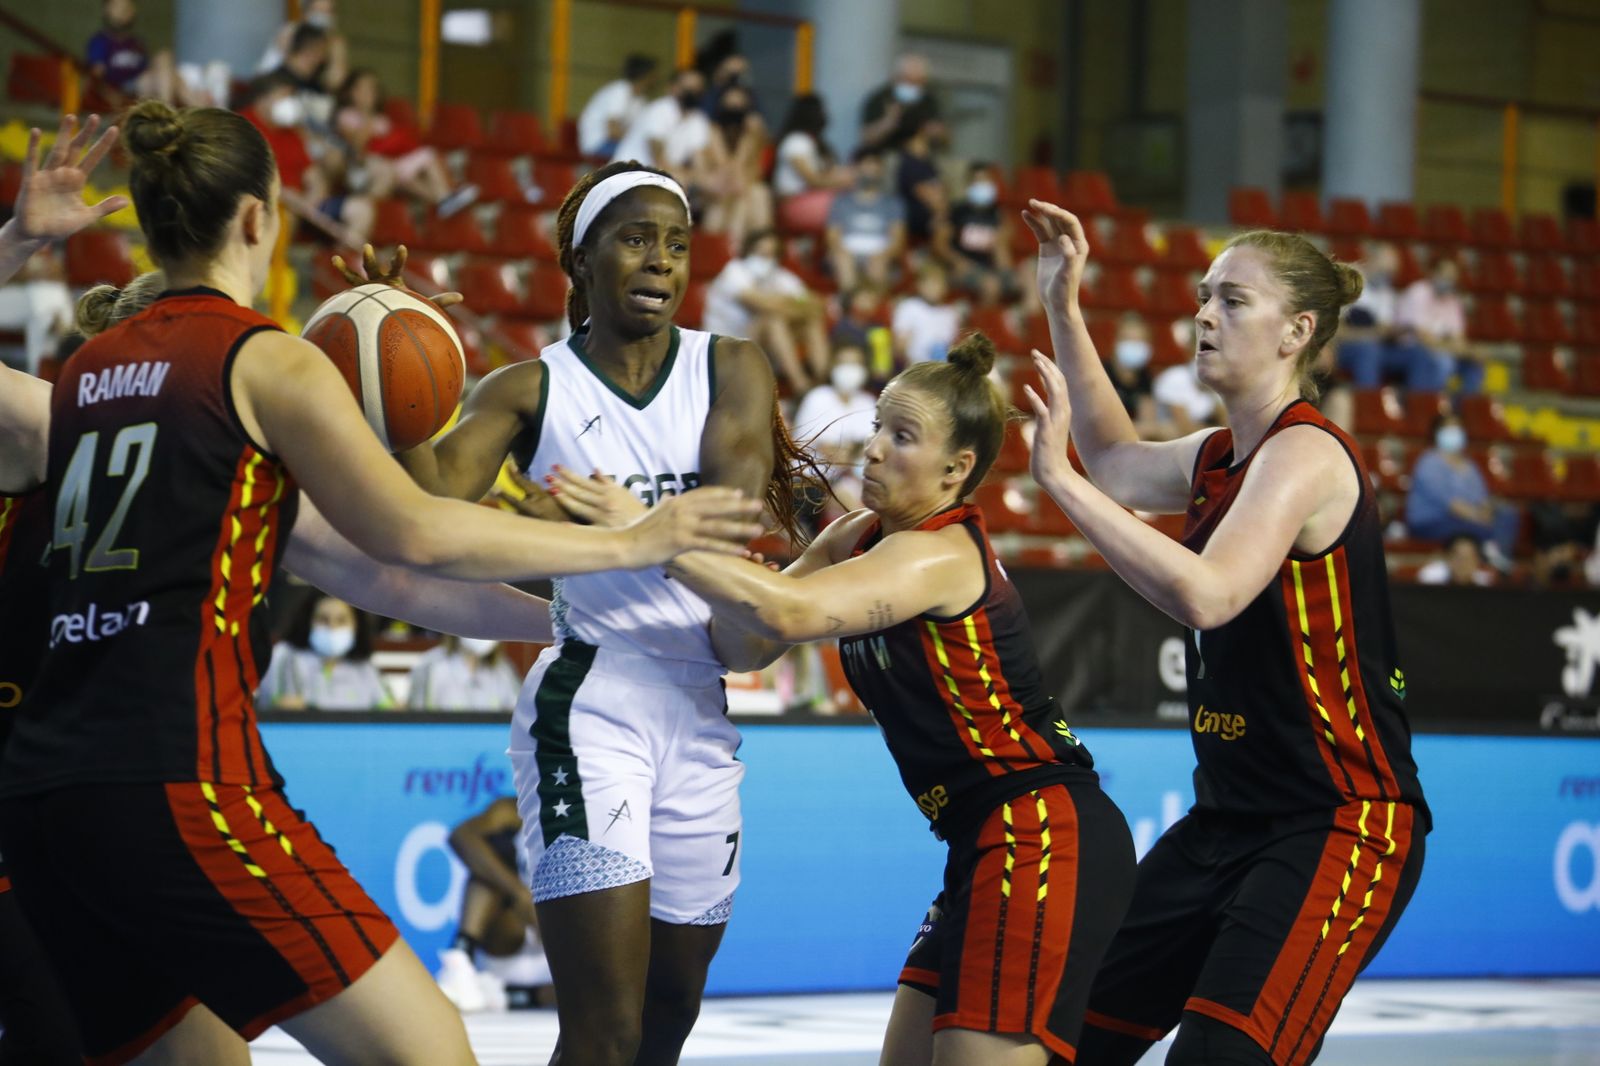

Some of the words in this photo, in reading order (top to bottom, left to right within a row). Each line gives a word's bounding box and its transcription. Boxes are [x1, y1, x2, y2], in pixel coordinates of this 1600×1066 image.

[78, 362, 170, 406] RAMAN
[53, 422, 157, 580] 42
[722, 831, 739, 876] 7
